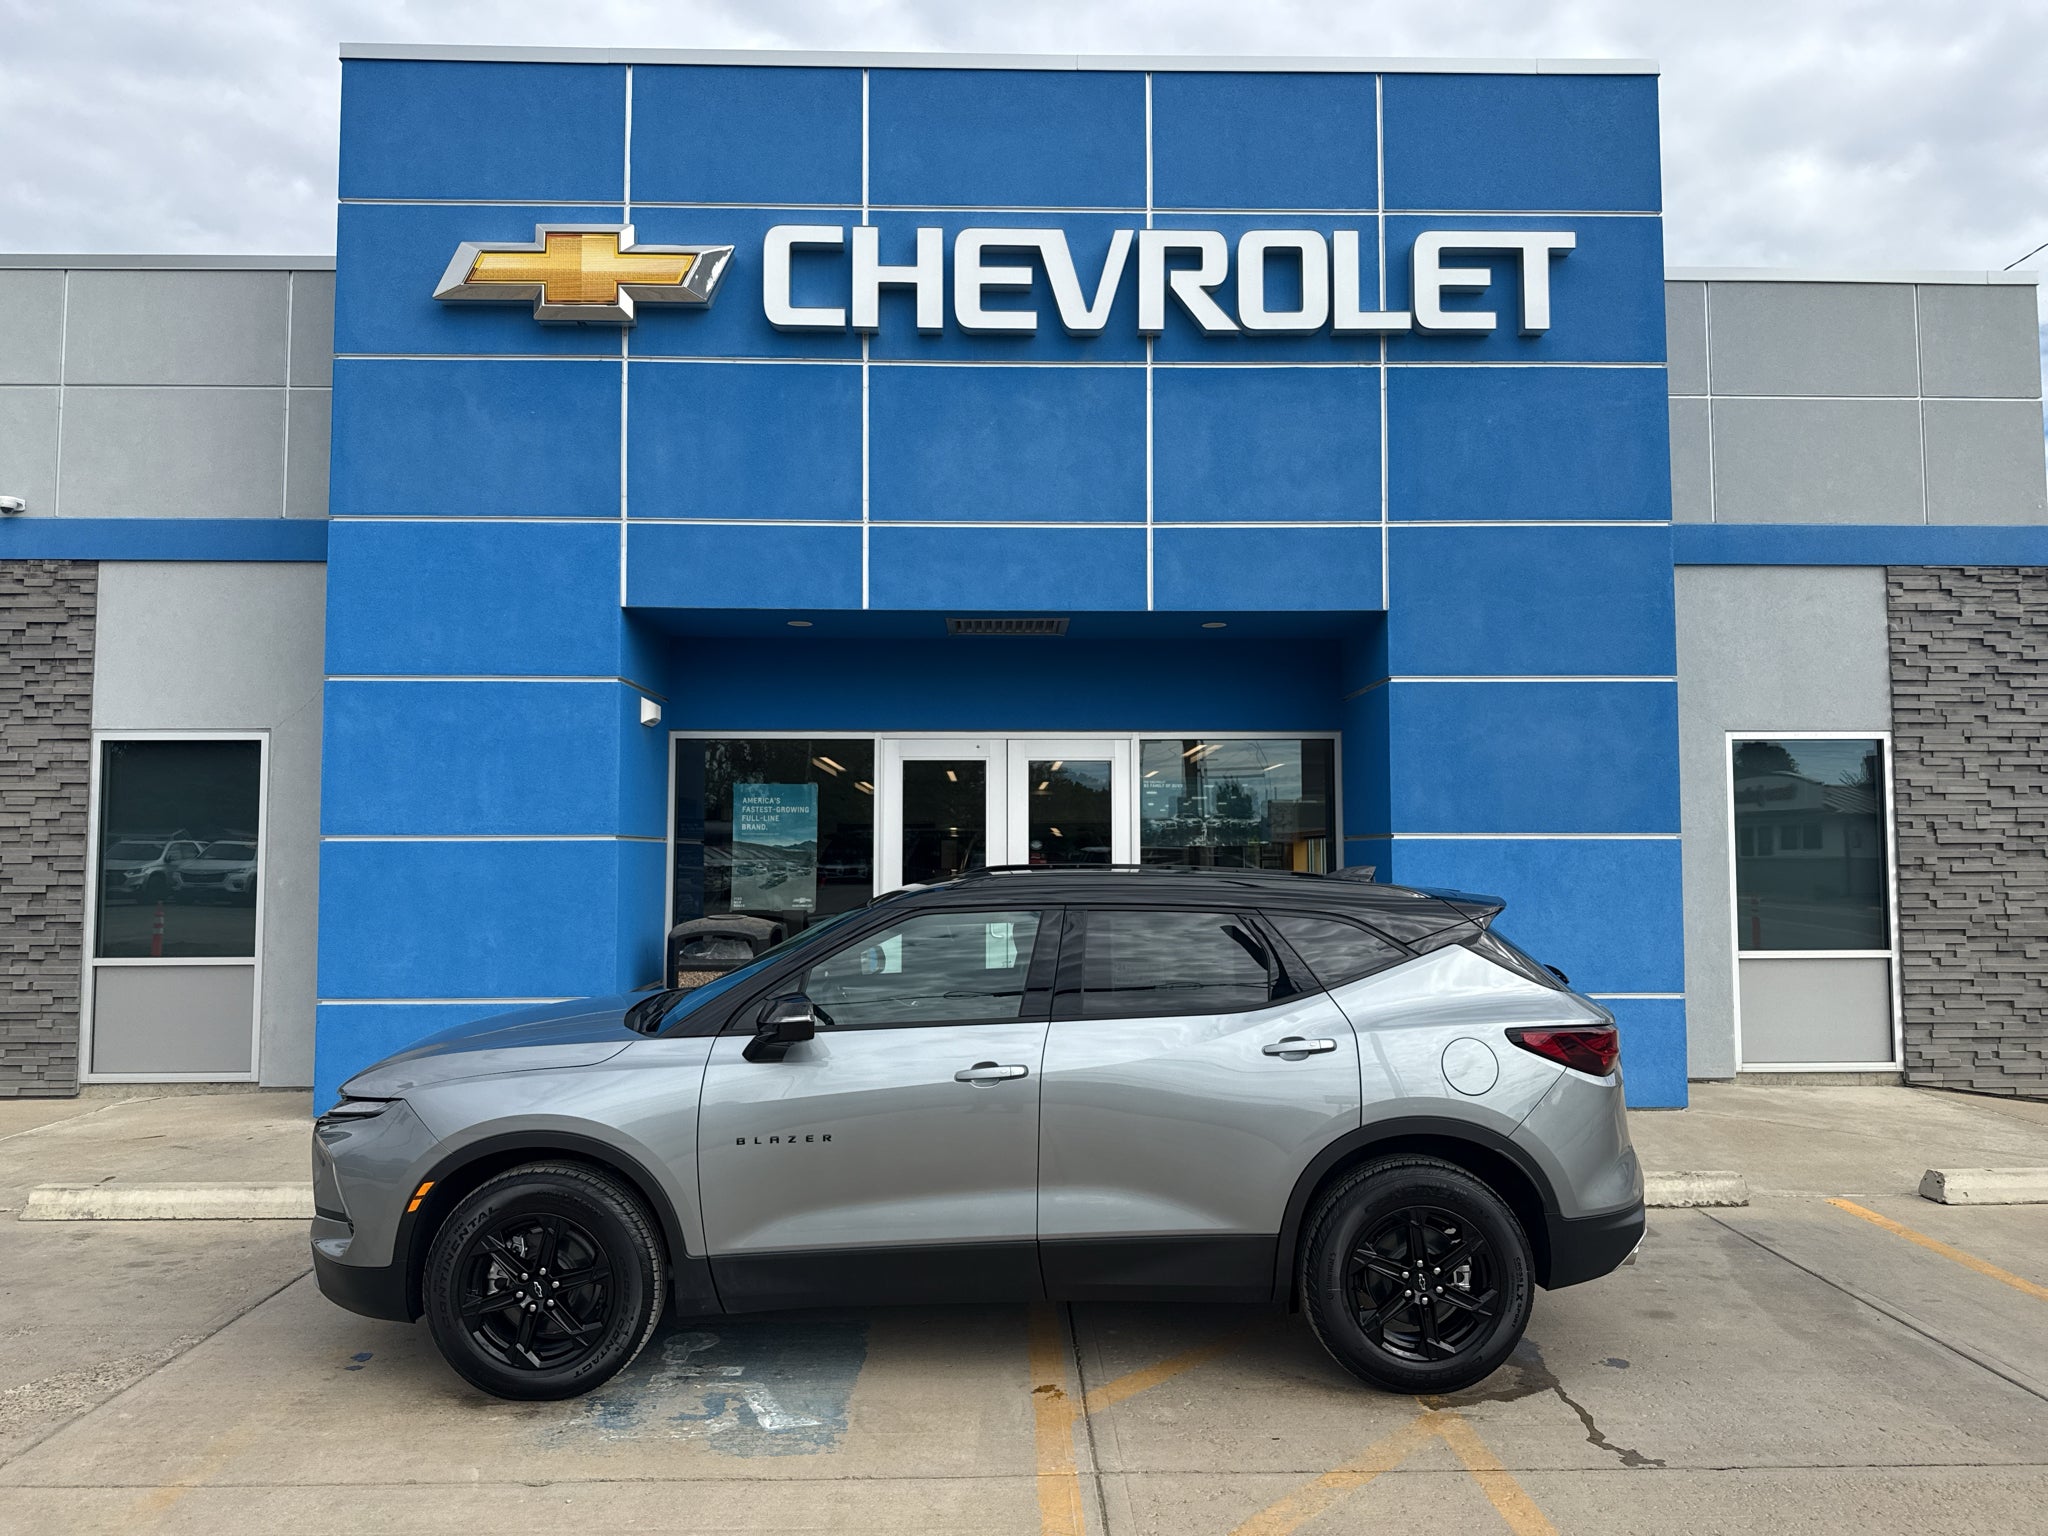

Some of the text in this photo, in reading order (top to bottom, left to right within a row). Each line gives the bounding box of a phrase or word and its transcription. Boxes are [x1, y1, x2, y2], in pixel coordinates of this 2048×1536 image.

[763, 225, 1577, 335] CHEVROLET
[741, 823, 768, 831] BRAND.
[735, 1133, 832, 1146] BLAZER
